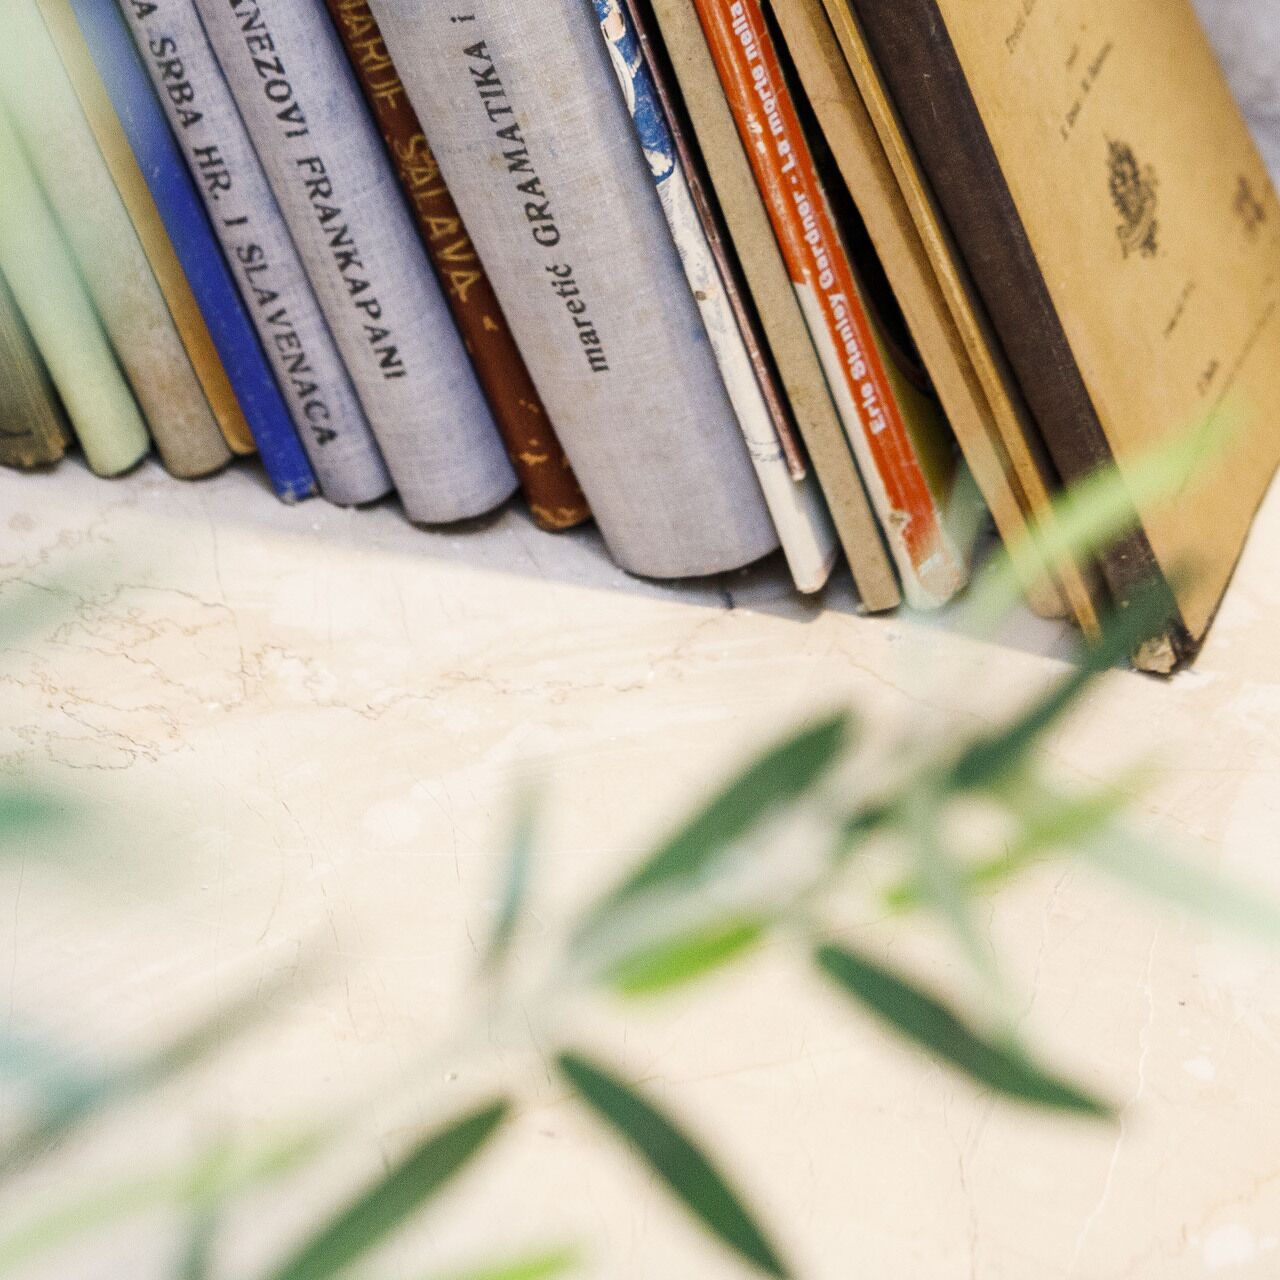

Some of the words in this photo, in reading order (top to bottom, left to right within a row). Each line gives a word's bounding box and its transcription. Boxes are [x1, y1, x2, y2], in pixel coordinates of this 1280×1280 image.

[149, 33, 205, 129] SRBA
[751, 62, 786, 134] morte
[190, 145, 236, 202] HR.
[463, 39, 561, 248] GRAMATIKA
[776, 138, 798, 173] La
[223, 215, 248, 229] I
[393, 134, 482, 303] SALAVA
[792, 189, 836, 291] Gardner
[295, 155, 409, 383] FRANKAPANI
[235, 241, 340, 448] SLAVENACA
[545, 262, 611, 373] maretić
[827, 294, 867, 382] Stanley
[857, 381, 886, 435] Erle
